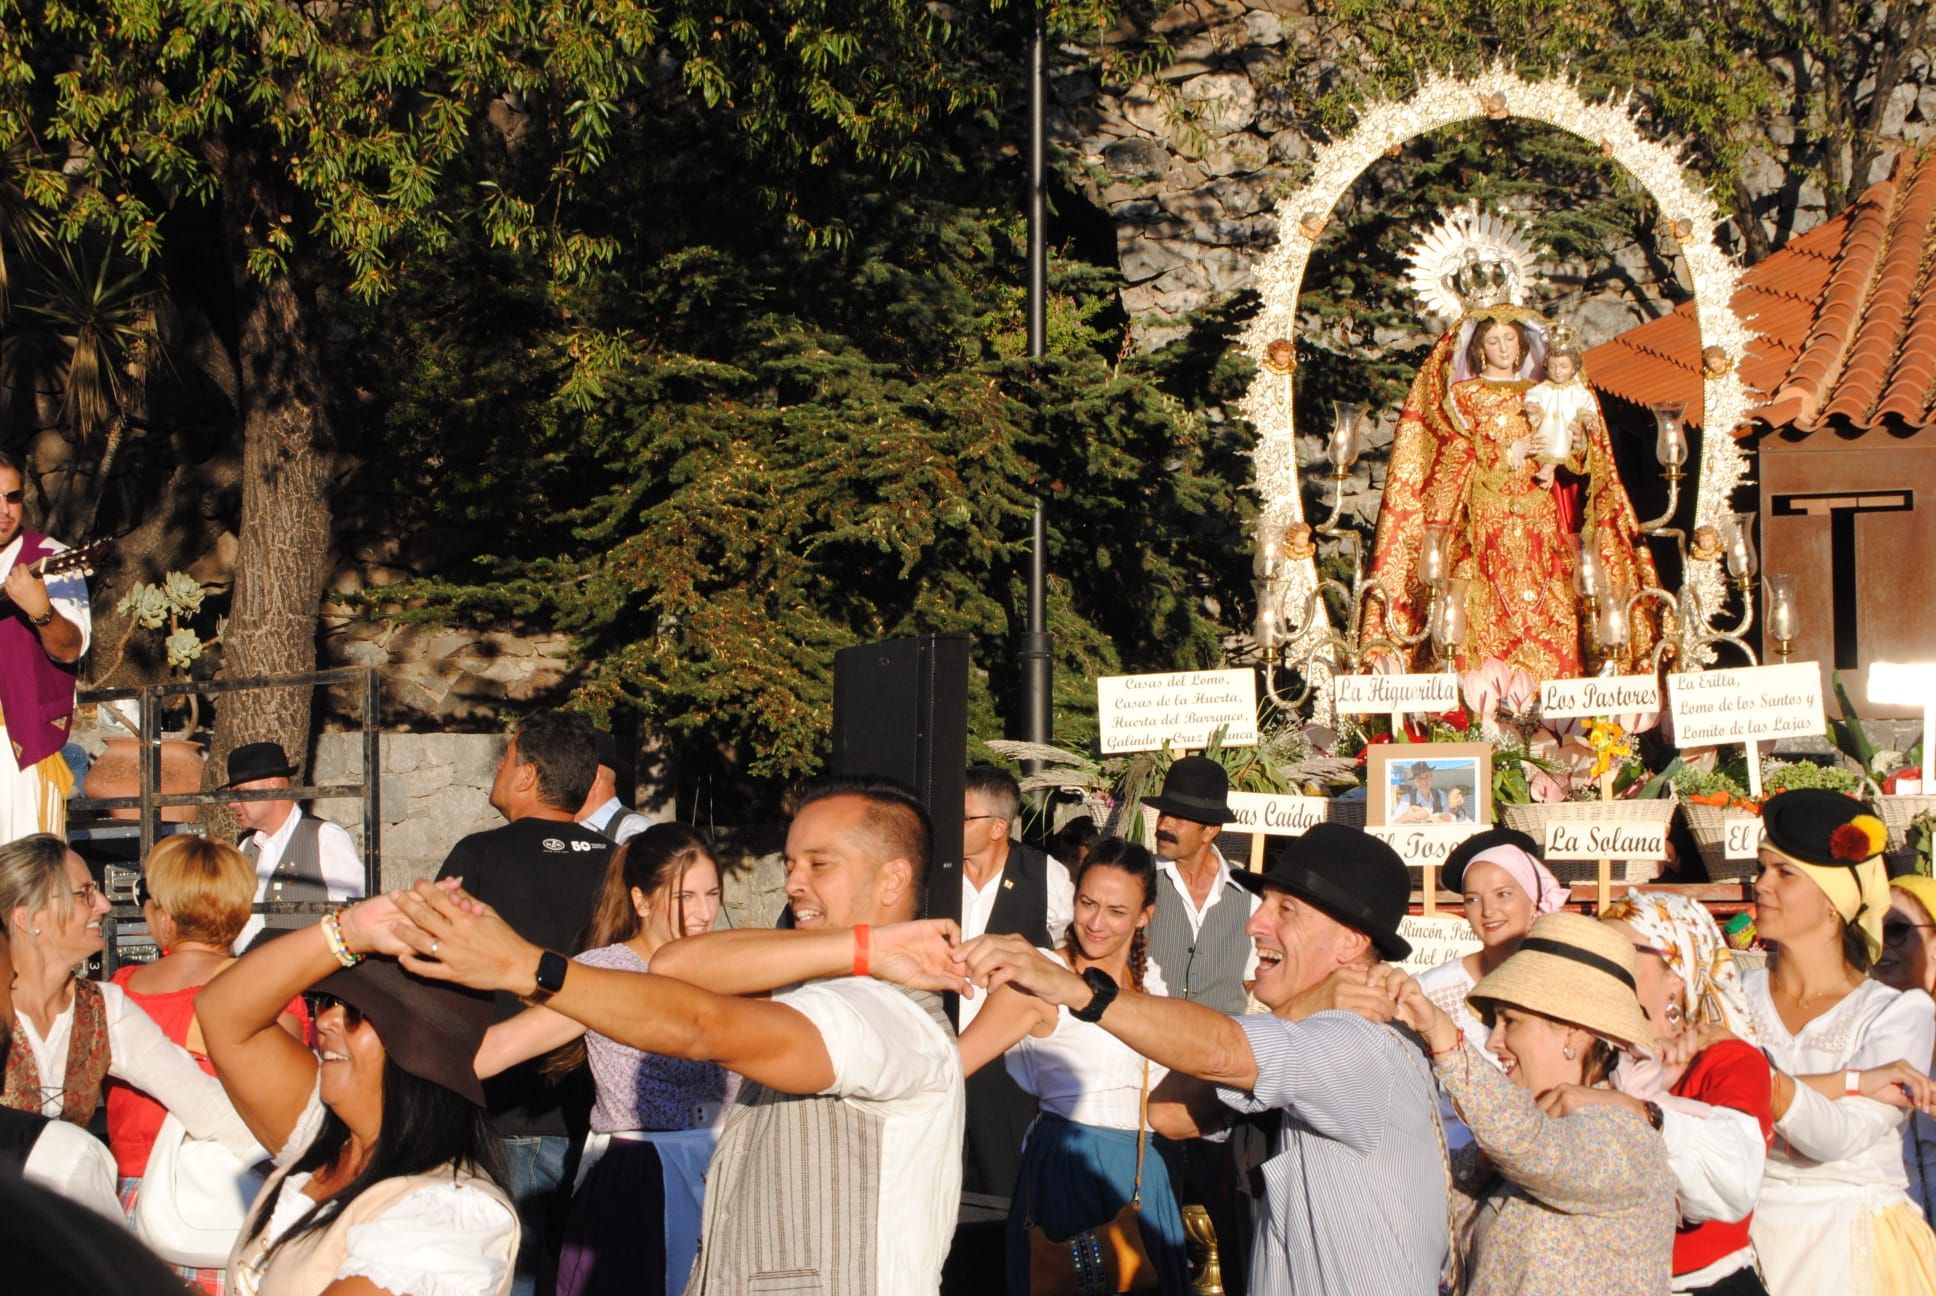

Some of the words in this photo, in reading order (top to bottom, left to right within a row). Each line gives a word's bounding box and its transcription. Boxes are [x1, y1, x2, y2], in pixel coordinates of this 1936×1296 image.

[1125, 677, 1162, 690] Casas
[1167, 675, 1185, 687] del
[1192, 673, 1230, 686] Lomo,
[1338, 677, 1362, 702] La
[1367, 676, 1456, 710] Higuerilla
[1677, 675, 1695, 690] La
[1698, 673, 1741, 689] Erilla,
[1115, 697, 1152, 710] Casas
[1156, 695, 1171, 707] de
[1174, 694, 1188, 706] la
[1191, 691, 1243, 705] Huerta,
[1544, 685, 1576, 711] Los
[1582, 682, 1657, 709] Pastores
[1679, 700, 1714, 715] Lomo
[1718, 697, 1733, 712] de
[1736, 695, 1755, 711] los
[1759, 692, 1803, 708] Santos
[1806, 694, 1816, 708] y
[1111, 715, 1157, 728] Huerta
[1161, 713, 1180, 725] del
[1184, 711, 1249, 725] Barranco,
[1682, 724, 1725, 740] Lomito
[1729, 720, 1745, 736] de
[1747, 719, 1768, 734] las
[1772, 716, 1812, 732] Lajas
[1106, 734, 1156, 750] Galindo
[1172, 731, 1204, 743] Cruz
[1264, 799, 1322, 829] Caídas
[1548, 825, 1579, 852] La
[1586, 825, 1663, 853] Solana
[1728, 825, 1751, 852] El
[1399, 918, 1447, 942] Rincón,
[1414, 947, 1437, 965] del
